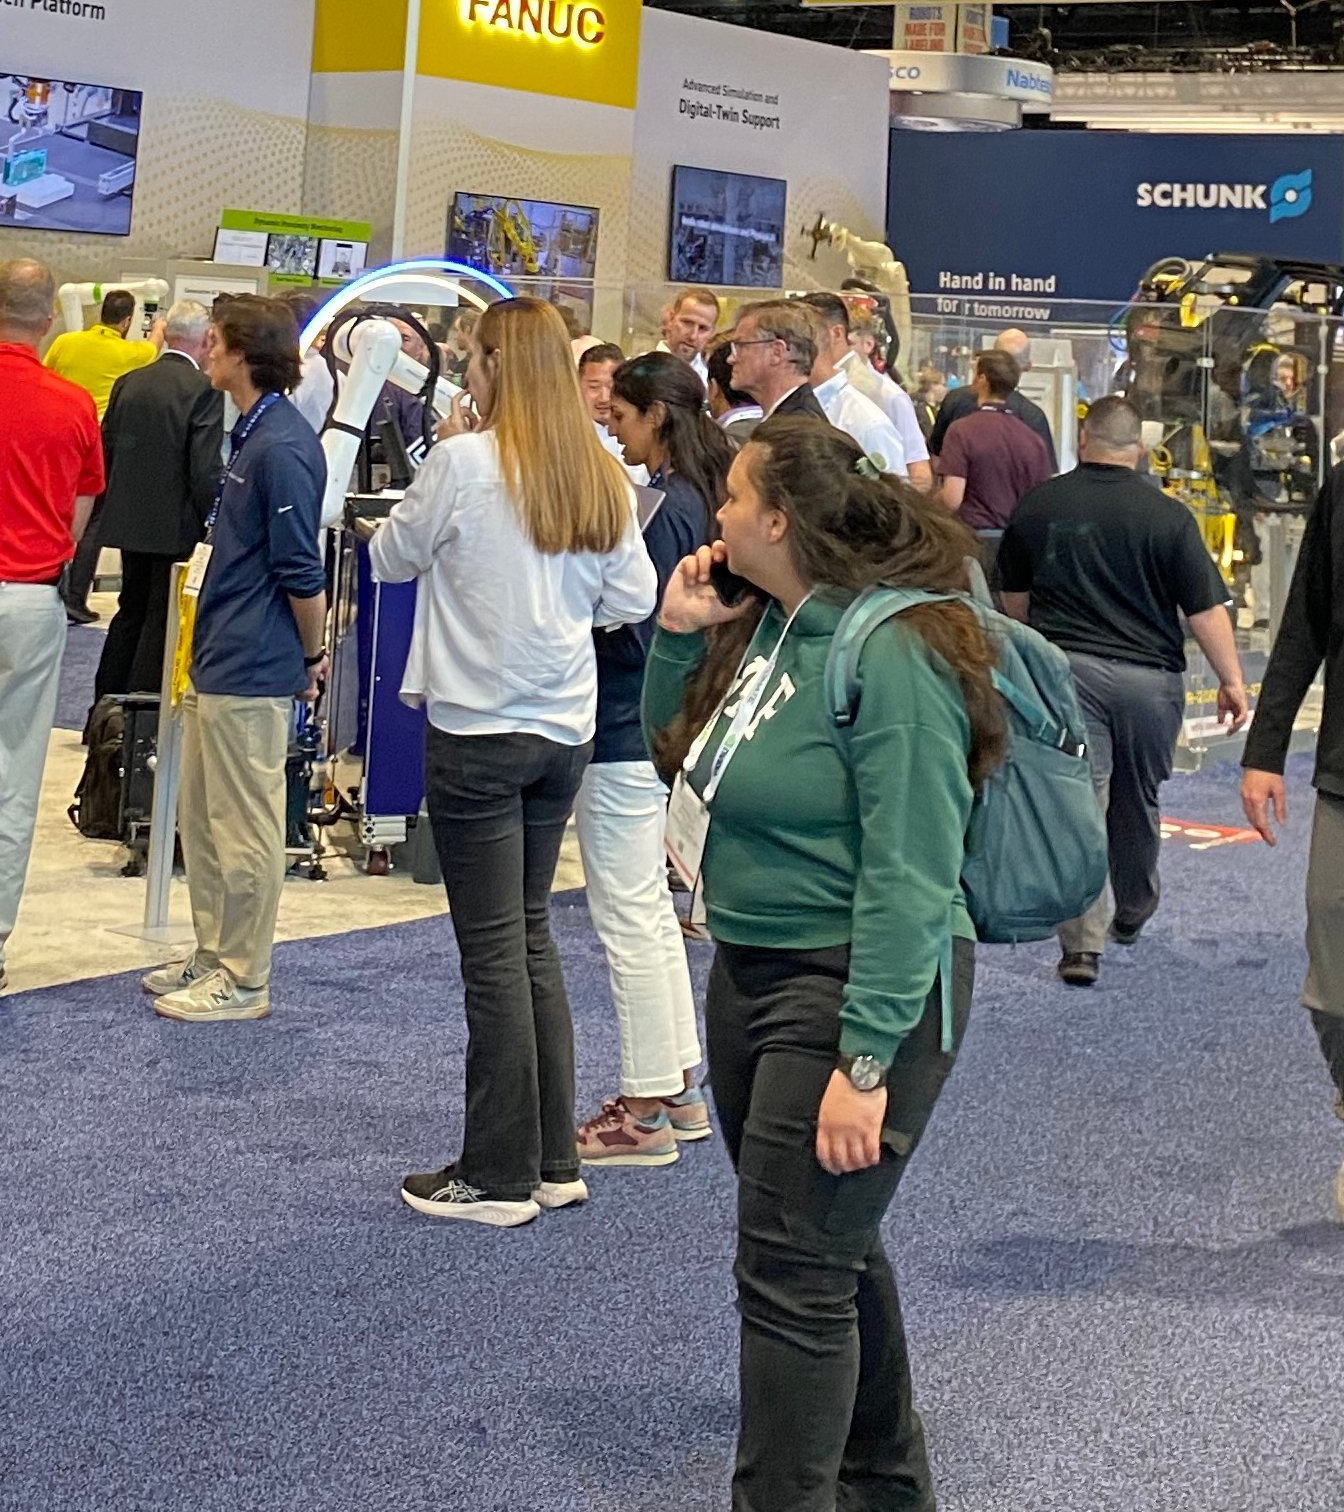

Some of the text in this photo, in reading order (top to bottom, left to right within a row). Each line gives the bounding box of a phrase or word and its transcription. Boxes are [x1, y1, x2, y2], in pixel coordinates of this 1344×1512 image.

[683, 78, 778, 106] Advanced Simulation and
[679, 98, 780, 130] Digital-Twin Support
[1136, 182, 1267, 209] SCHUNK
[939, 271, 1056, 293] Hand in hand
[973, 302, 1051, 320] tomorrow
